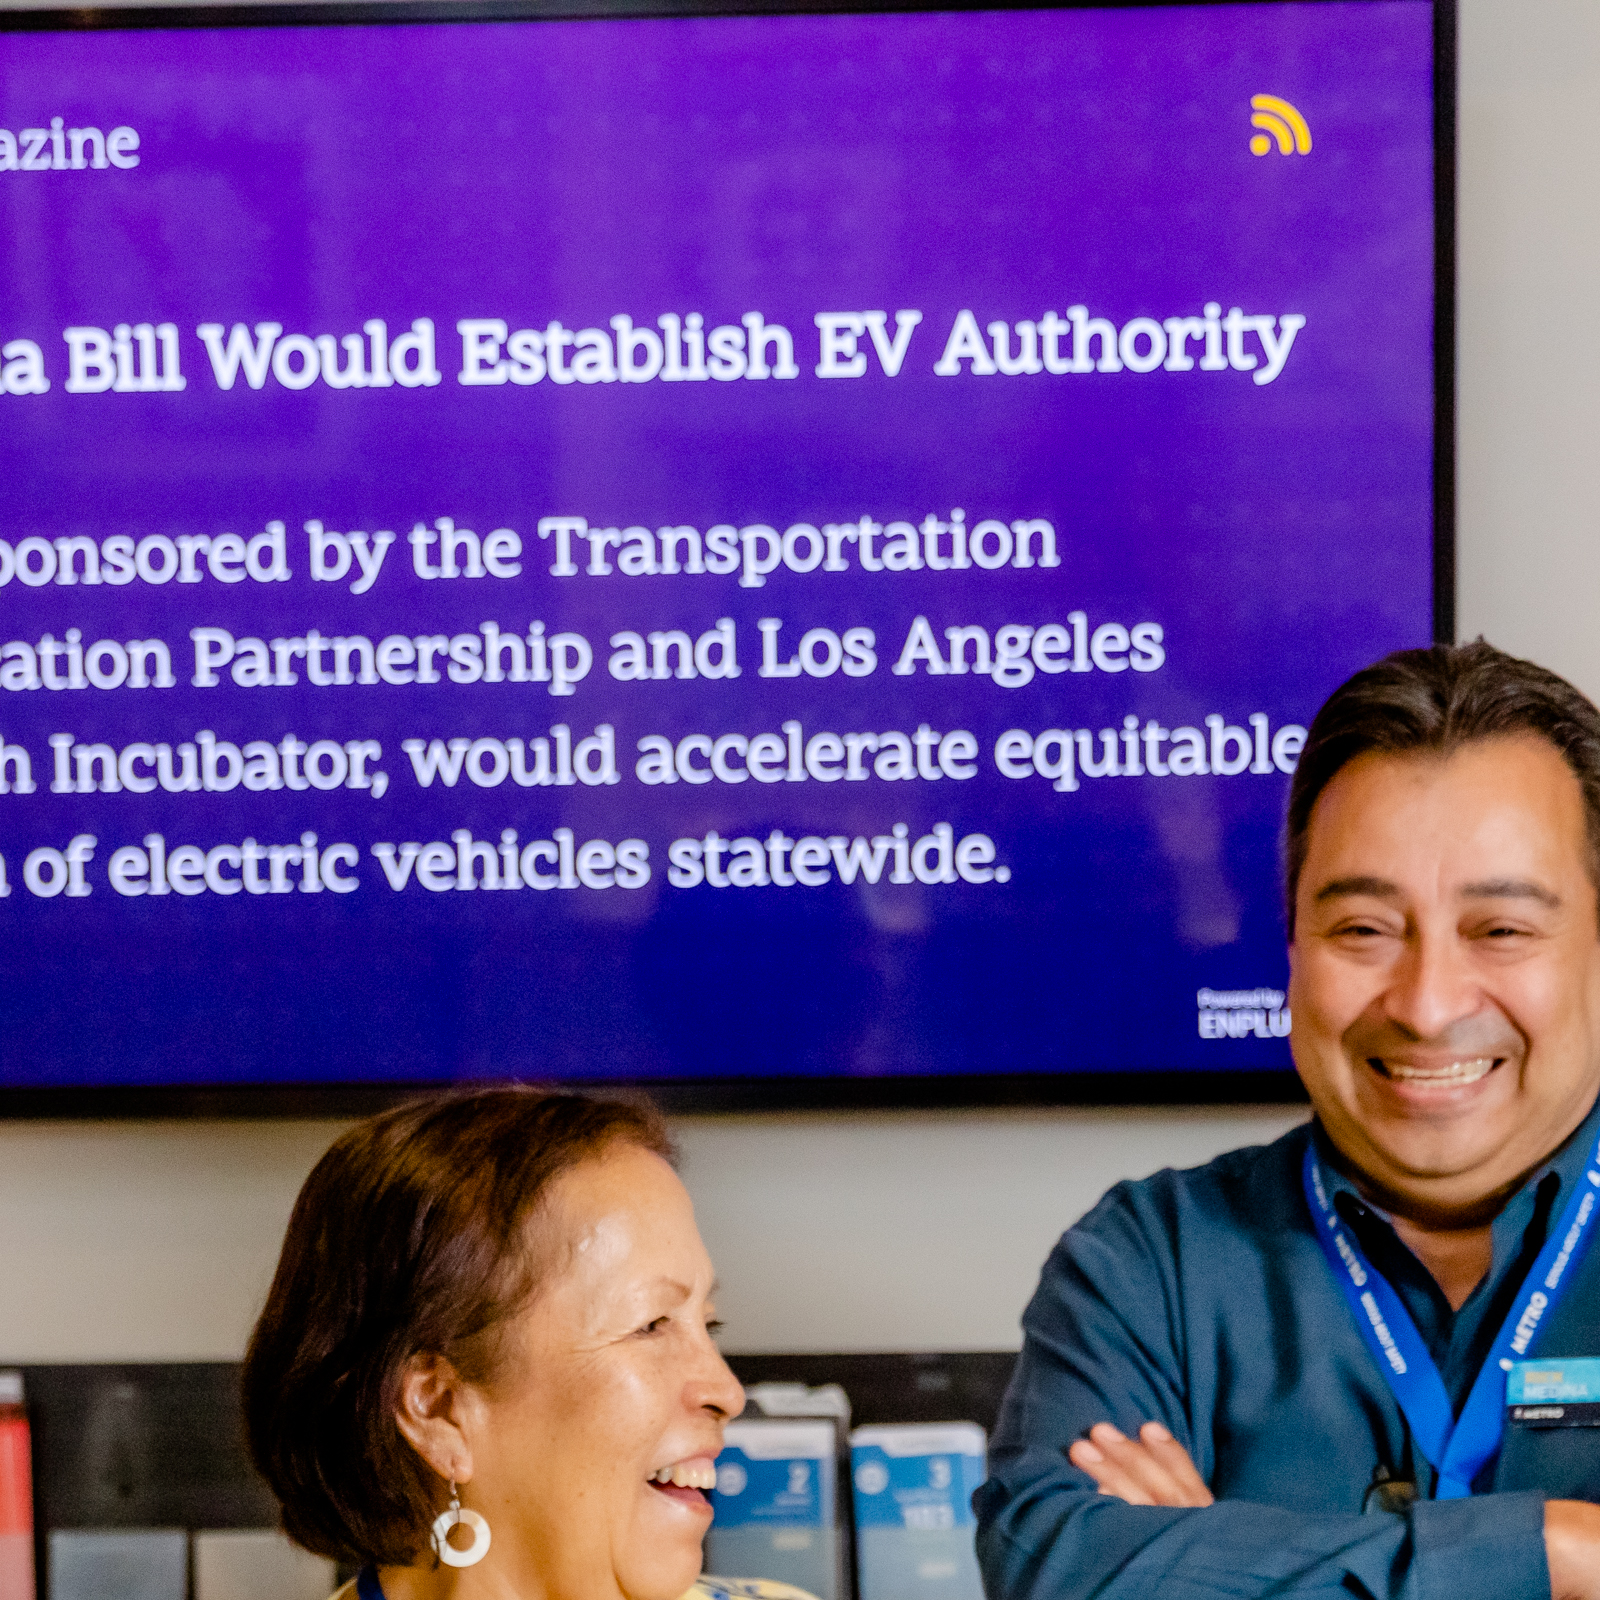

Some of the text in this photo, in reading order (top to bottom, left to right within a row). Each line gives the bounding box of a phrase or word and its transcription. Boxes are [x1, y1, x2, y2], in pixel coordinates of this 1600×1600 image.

[63, 322, 186, 393] Bill
[197, 317, 441, 390] Would
[457, 311, 799, 386] Establish
[814, 310, 922, 379] EV
[933, 302, 1306, 386] Authority
[304, 519, 396, 594] by
[408, 516, 522, 579] the
[537, 508, 1061, 588] Transportation
[190, 619, 593, 696] Partnership
[608, 617, 742, 681] and
[757, 617, 877, 677] Los
[892, 610, 1165, 688] Angeles
[49, 730, 389, 799] Incubator,
[402, 723, 621, 787] would
[635, 720, 979, 785] accelerate
[994, 712, 1308, 792] equitable
[23, 834, 98, 898] of
[108, 831, 360, 897] electric
[372, 827, 651, 892] vehicles
[667, 822, 1012, 889] statewide.
[1198, 1008, 1292, 1039] ENPLU
[1335, 1234, 1367, 1286] METRO
[1510, 1291, 1548, 1354] METRO
[930, 1458, 951, 1490] 3
